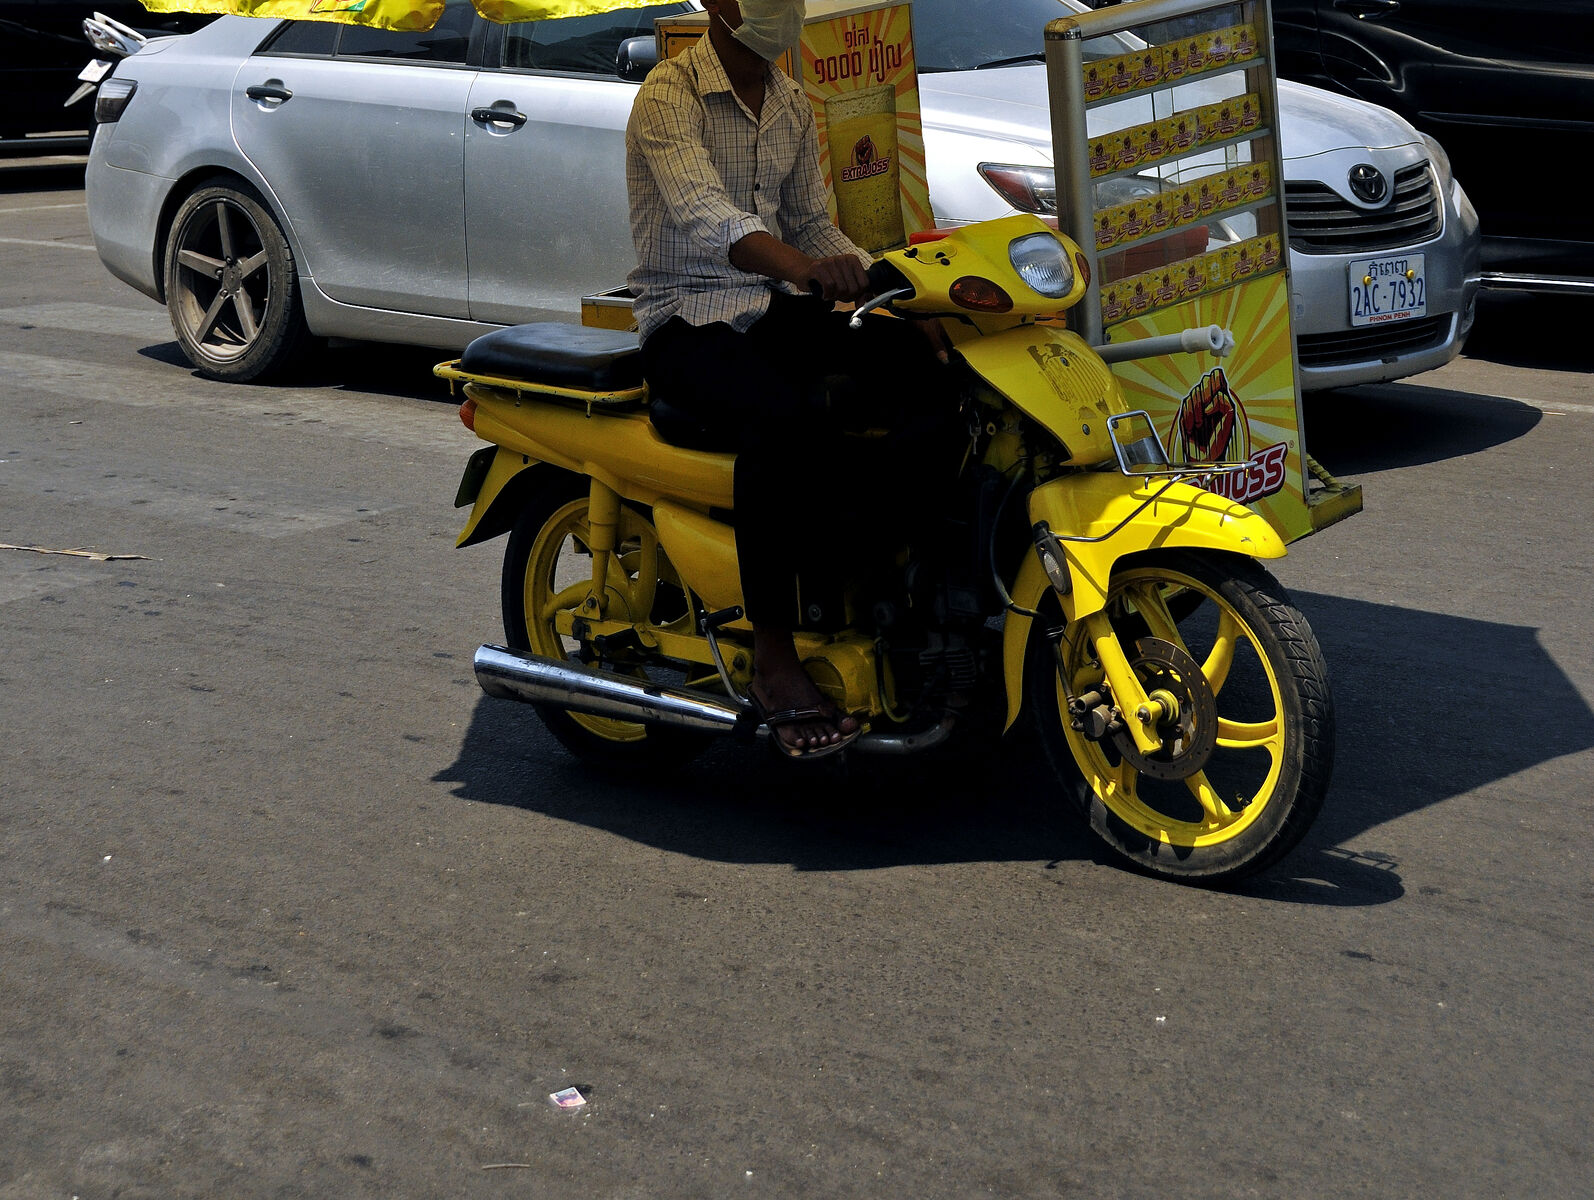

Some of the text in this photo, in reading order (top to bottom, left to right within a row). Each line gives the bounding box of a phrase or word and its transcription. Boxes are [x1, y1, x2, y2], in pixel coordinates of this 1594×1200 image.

[841, 157, 890, 182] EXTRAJOSS
[1369, 311, 1411, 323] PHNOM PENH
